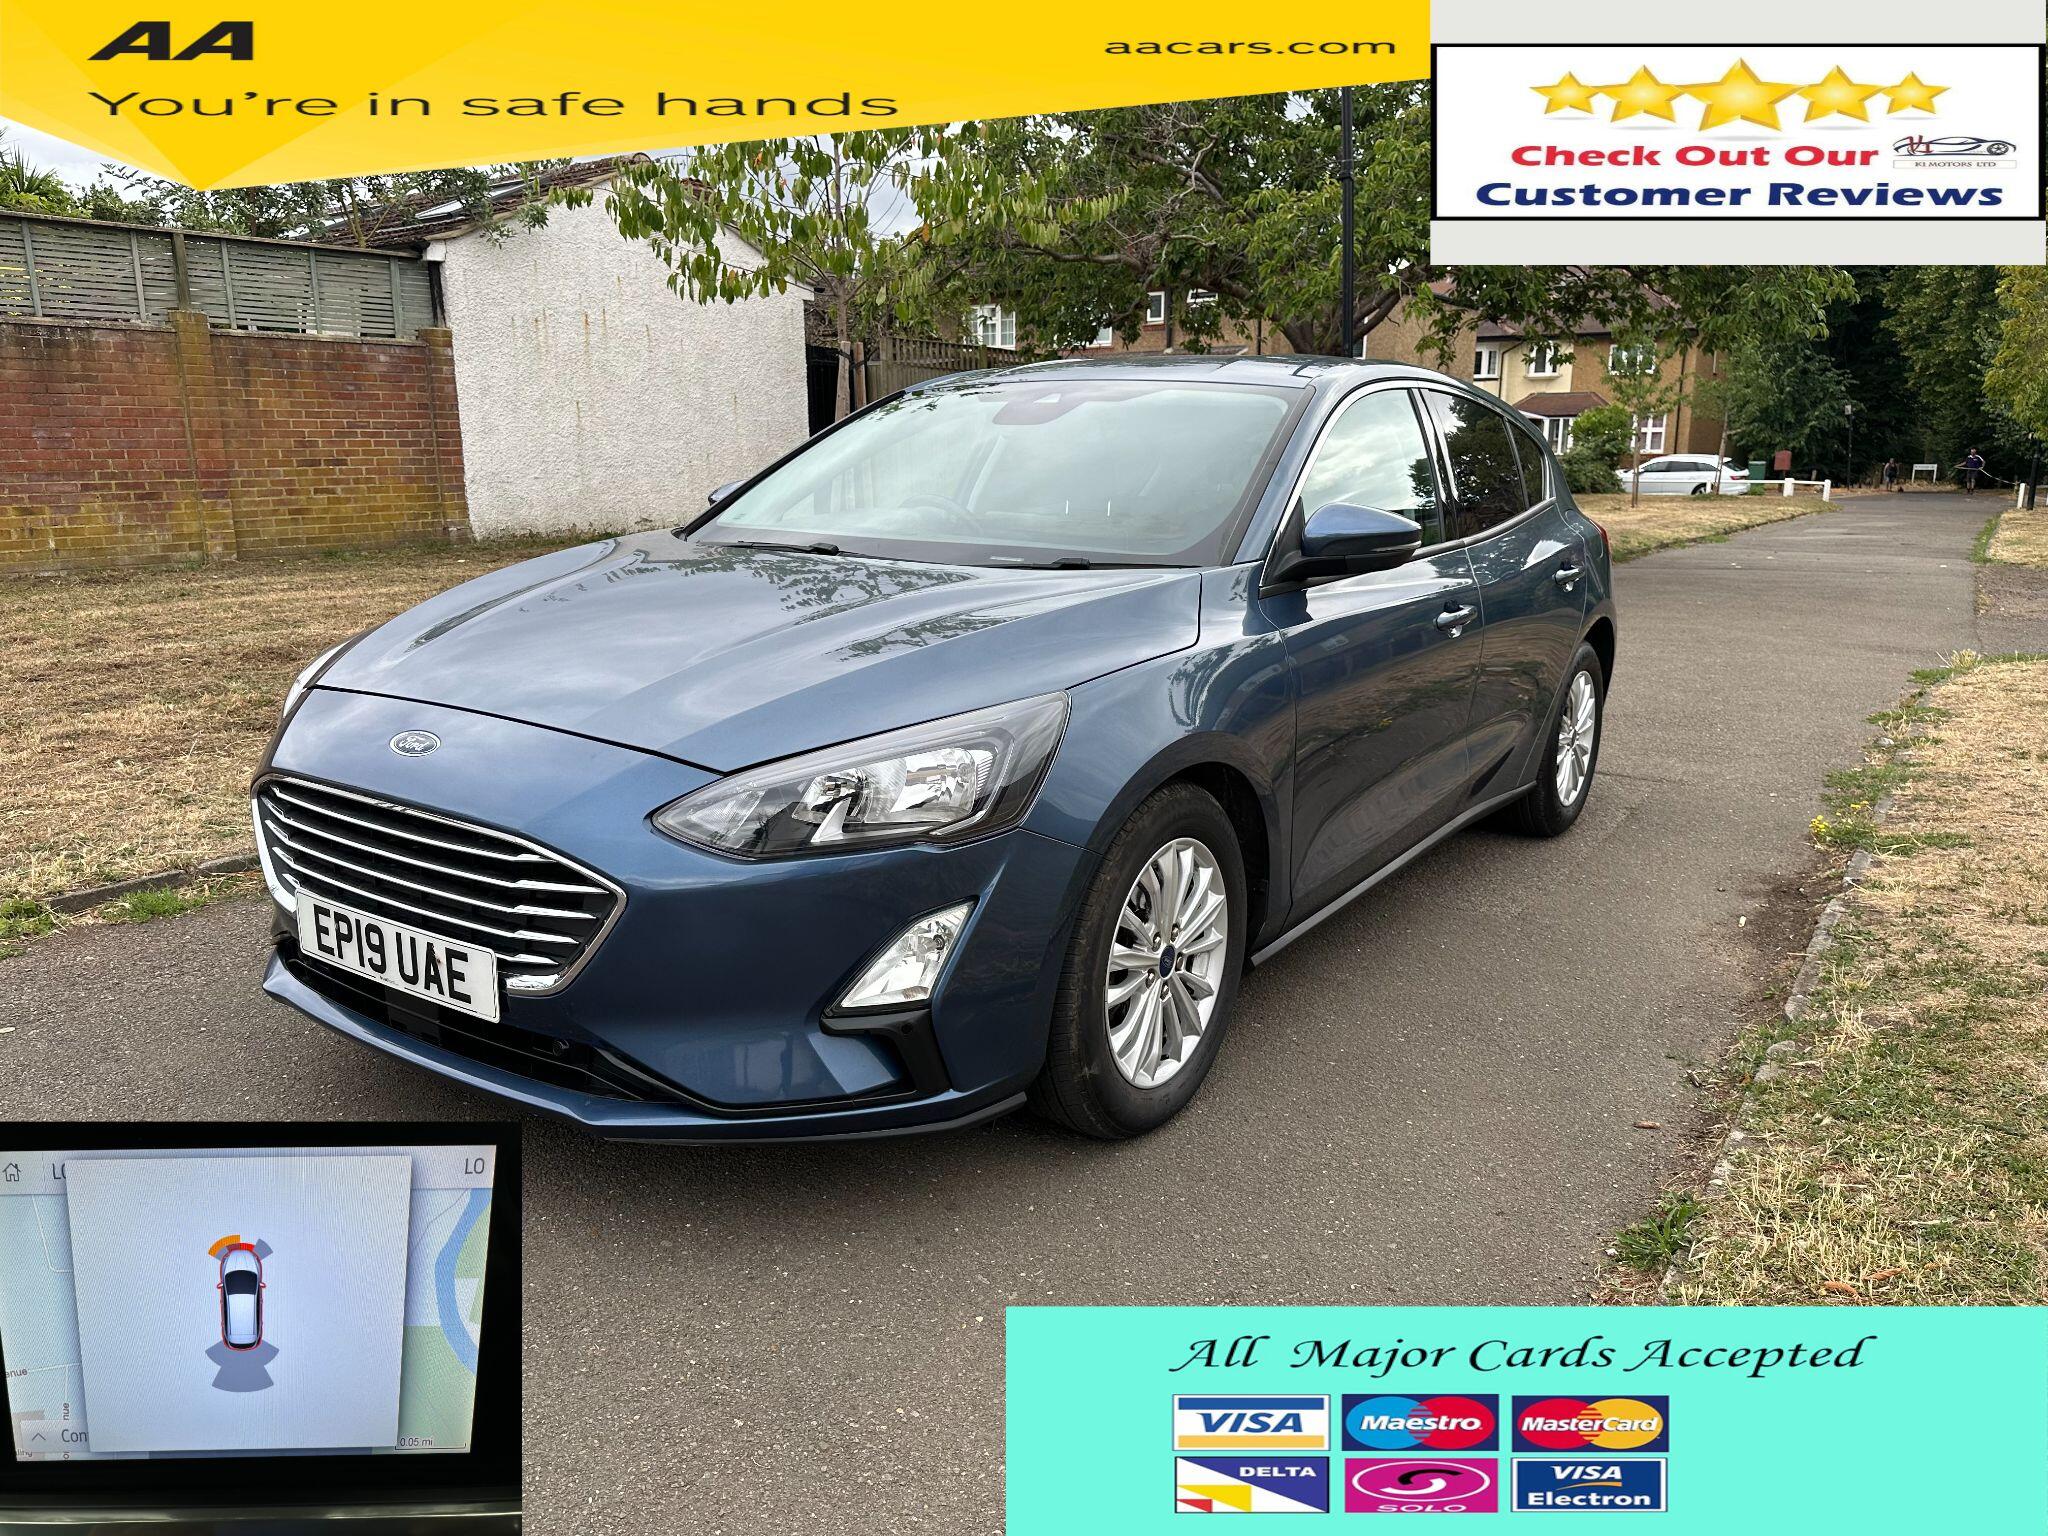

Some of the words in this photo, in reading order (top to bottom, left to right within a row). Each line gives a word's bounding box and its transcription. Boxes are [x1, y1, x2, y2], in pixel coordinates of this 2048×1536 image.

[313, 903, 389, 975] EP19
[395, 931, 472, 1005] UAE
[61, 1428, 88, 1443] Con
[400, 1437, 419, 1447] 0.05
[421, 1437, 433, 1446] mi
